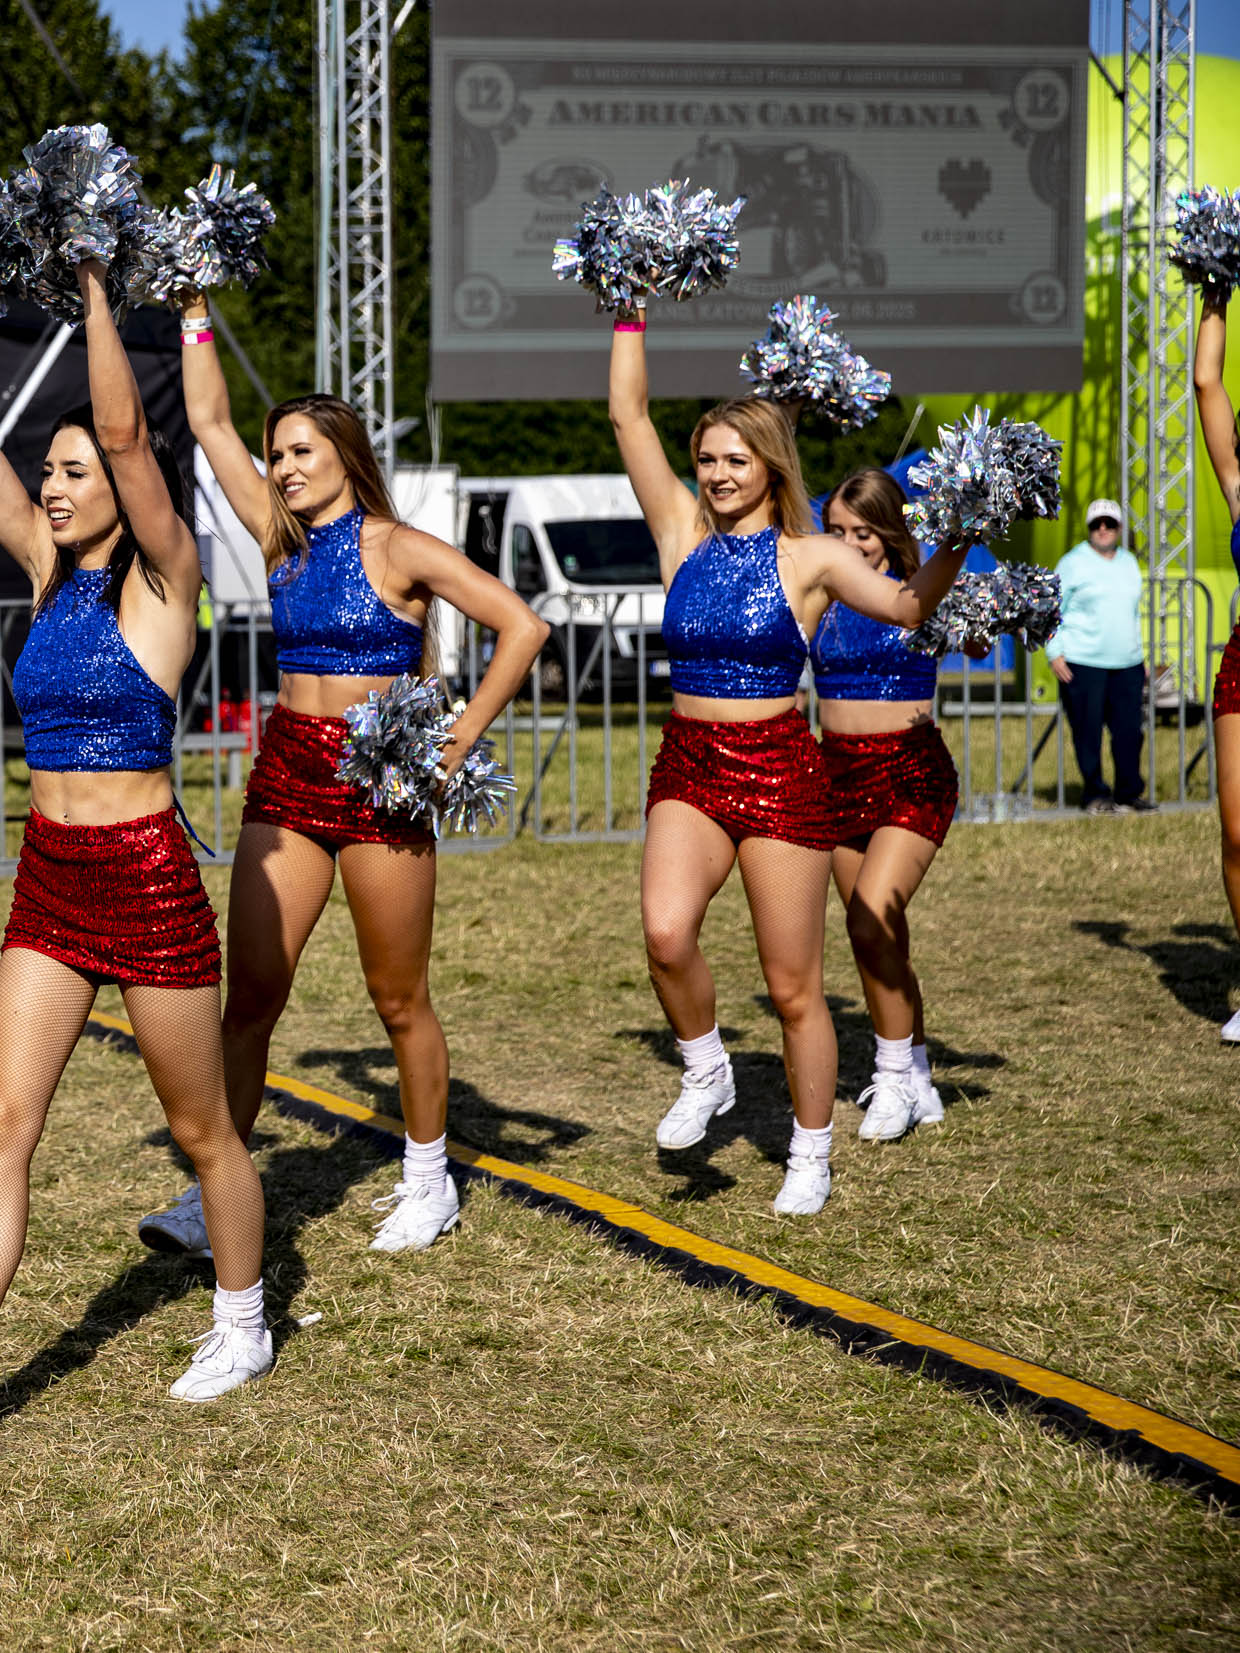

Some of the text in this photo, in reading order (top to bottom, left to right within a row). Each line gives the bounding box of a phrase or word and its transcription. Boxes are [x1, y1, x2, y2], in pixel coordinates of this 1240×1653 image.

[467, 76, 503, 112] 12
[1026, 81, 1060, 118] 12
[548, 99, 982, 129] AMERICAN CARS MANIA
[920, 230, 1007, 245] KATOWICE
